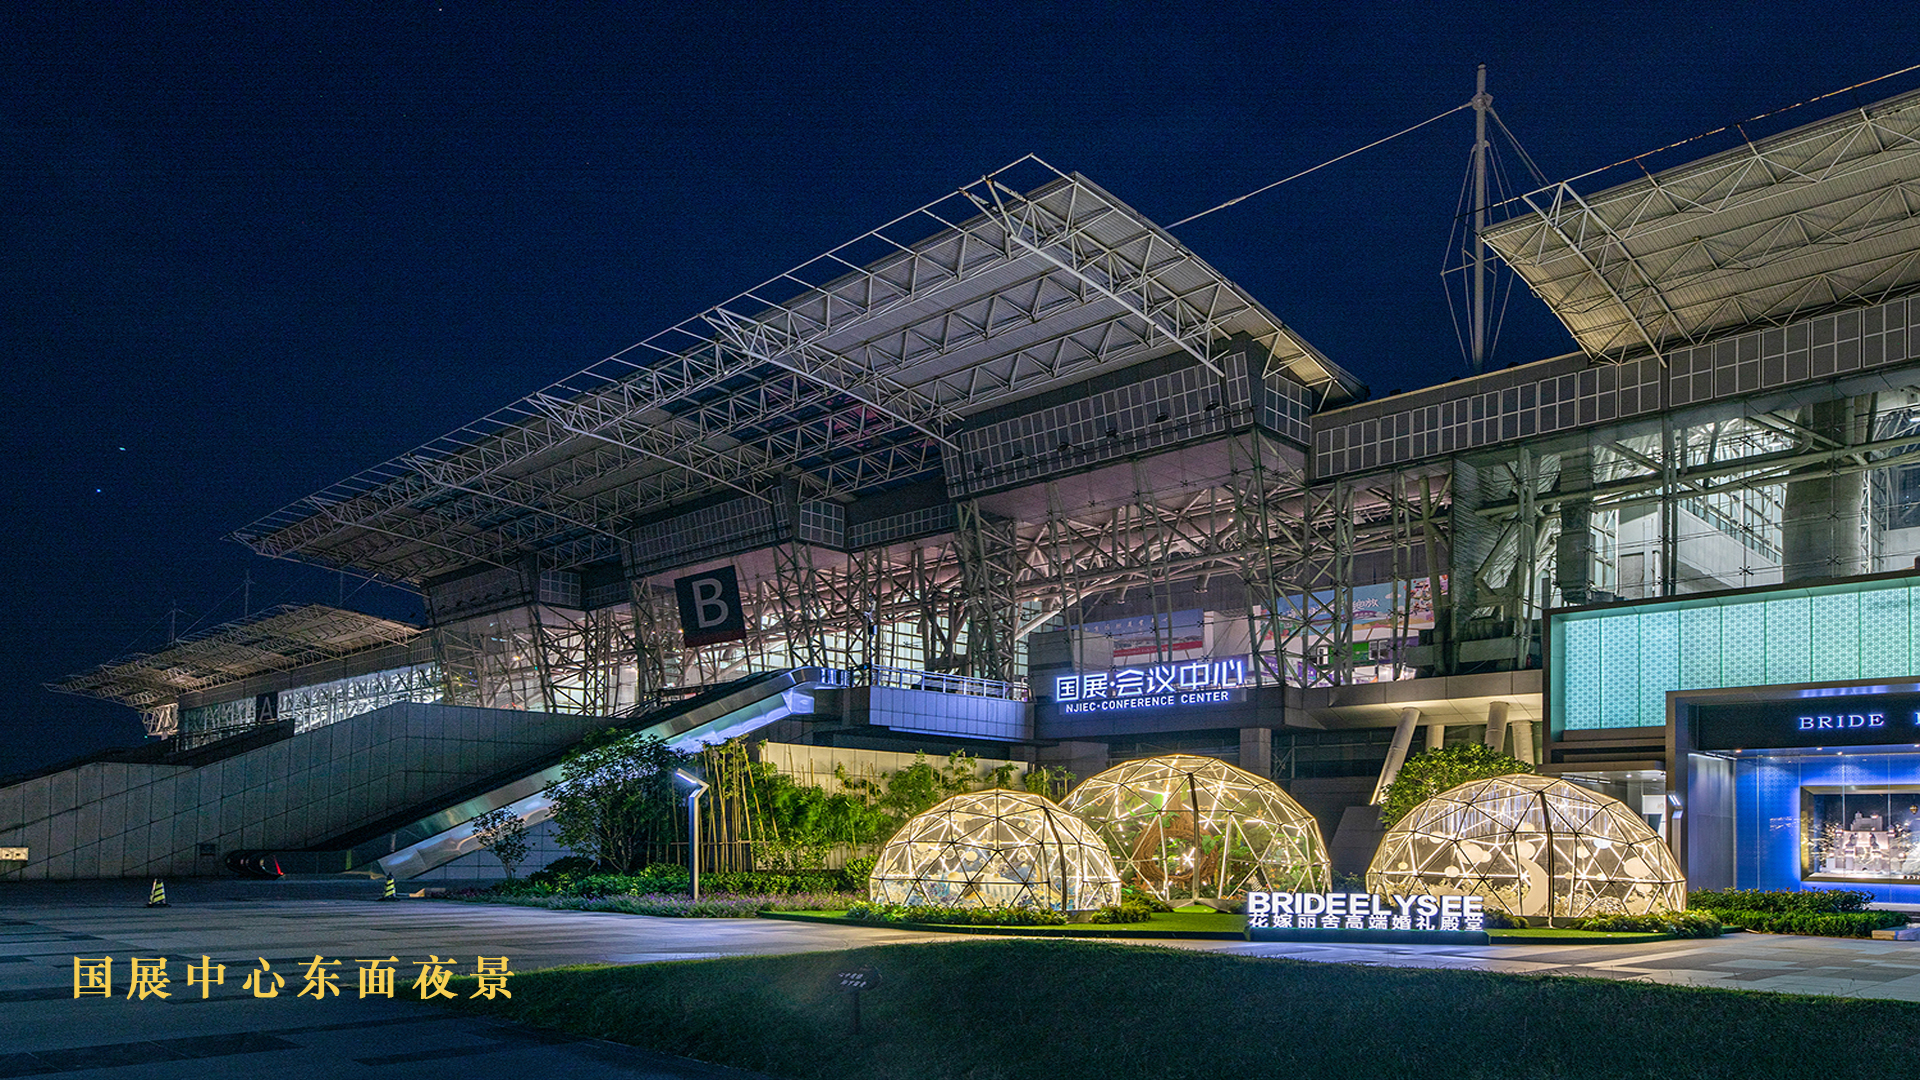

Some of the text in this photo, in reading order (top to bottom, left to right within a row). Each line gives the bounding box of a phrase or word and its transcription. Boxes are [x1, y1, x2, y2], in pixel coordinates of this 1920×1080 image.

[692, 577, 729, 629] B
[1181, 691, 1229, 704] CENTER
[260, 696, 274, 722] A
[1799, 713, 1884, 729] BRIDE
[1248, 891, 1484, 917] BRIDEELYSEE
[1249, 912, 1484, 931] 花嫁丽舍高端婚礼殿堂
